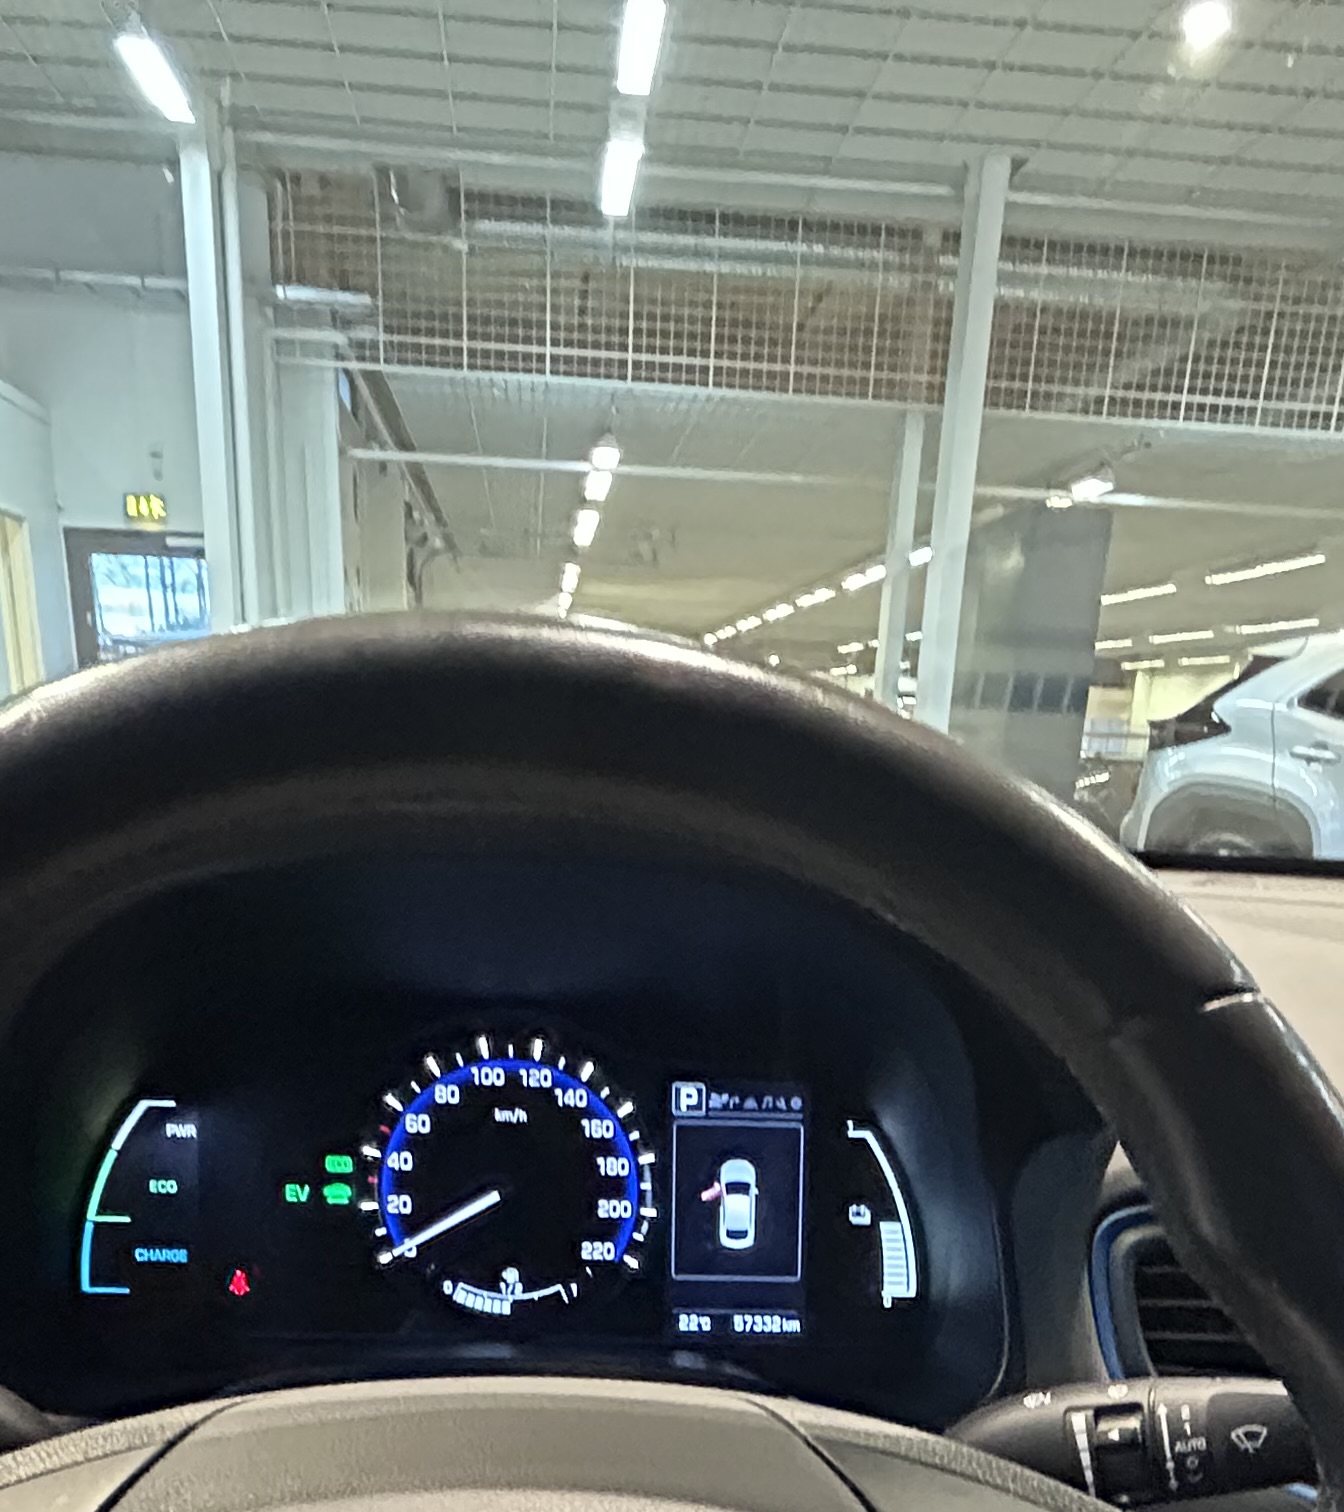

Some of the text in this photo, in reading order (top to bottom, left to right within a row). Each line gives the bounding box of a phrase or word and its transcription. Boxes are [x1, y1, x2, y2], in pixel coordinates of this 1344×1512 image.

[471, 1067, 505, 1086] 100
[520, 1068, 552, 1088] 120
[434, 1084, 460, 1104] 80
[555, 1088, 587, 1108] 140
[680, 1087, 698, 1112] P
[405, 1114, 431, 1134] 60
[494, 1107, 528, 1124] km/h
[165, 1123, 197, 1139] PWR
[581, 1118, 614, 1138] 160
[387, 1151, 413, 1171] 40
[597, 1156, 630, 1176] 180
[149, 1179, 178, 1194] ECO
[284, 1184, 310, 1202] EV
[387, 1194, 412, 1214] 20
[597, 1199, 632, 1218] 200
[580, 1241, 616, 1260] 220
[1174, 1437, 1207, 1453] AUTO
